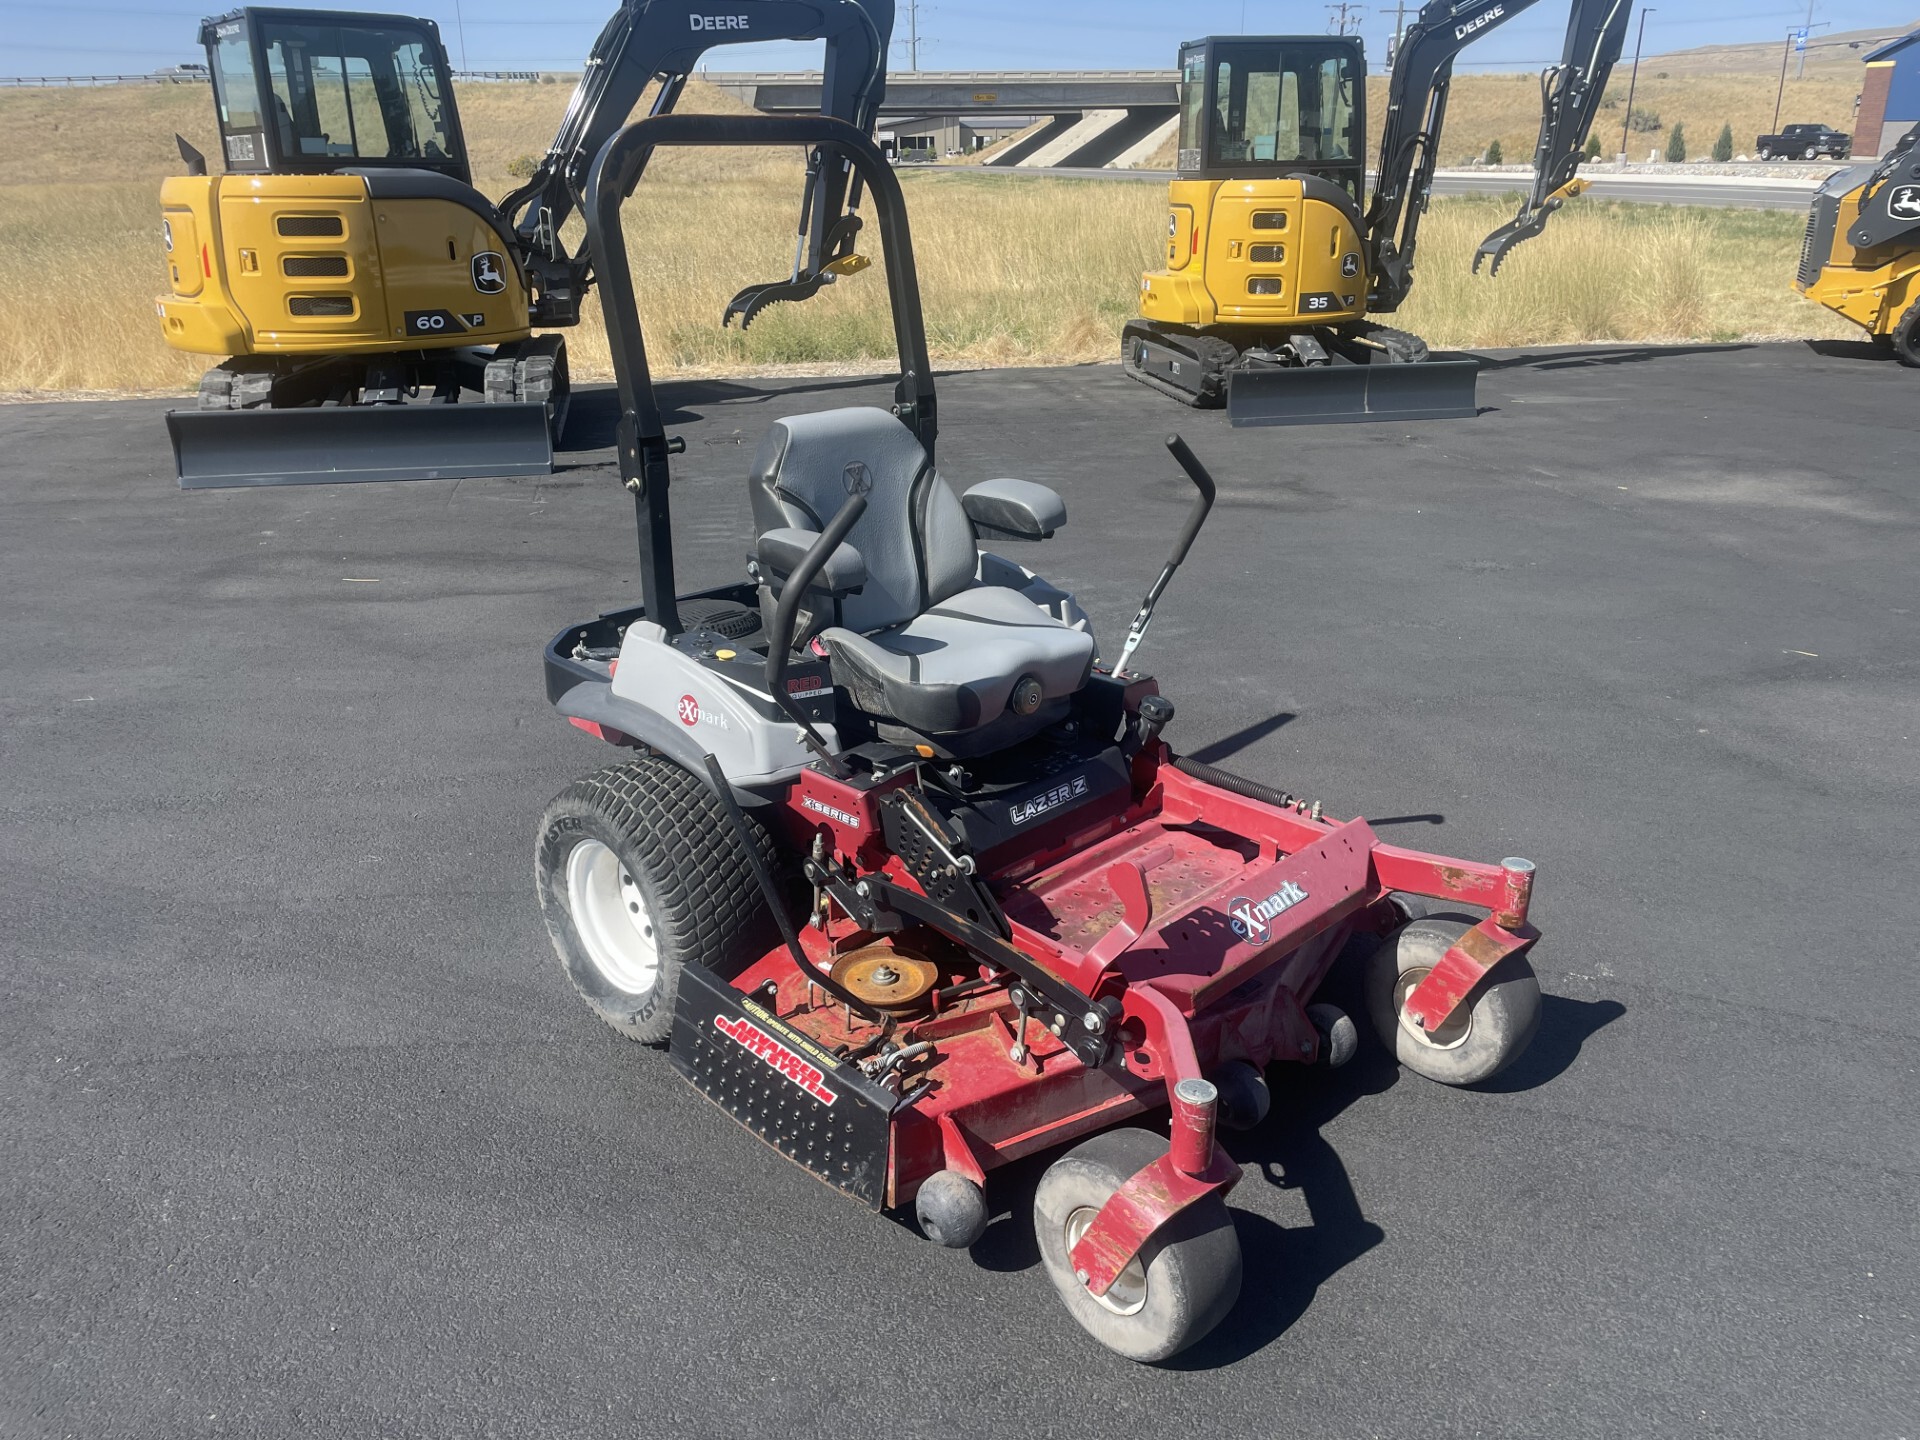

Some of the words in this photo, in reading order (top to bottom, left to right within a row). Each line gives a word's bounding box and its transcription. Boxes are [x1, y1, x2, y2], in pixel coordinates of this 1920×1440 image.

[689, 14, 749, 30] DEERE
[1455, 4, 1504, 40] DEERE
[1309, 297, 1328, 309] 35
[1347, 296, 1355, 305] P
[416, 315, 445, 329] 60
[473, 315, 482, 326] P
[787, 676, 821, 692] RED
[791, 690, 822, 699] QUIPPED
[678, 699, 728, 729] eXmark
[1011, 784, 1072, 824] LAZER
[1072, 776, 1087, 796] Z
[1231, 880, 1308, 938] eXmark
[735, 1020, 823, 1084] ADVANCED
[766, 1018, 790, 1036] OPERATE
[787, 1031, 802, 1045] WITH
[800, 1041, 819, 1056] SHIELD
[715, 1017, 765, 1057] CHUTE
[766, 1053, 835, 1104] SYSTEM
